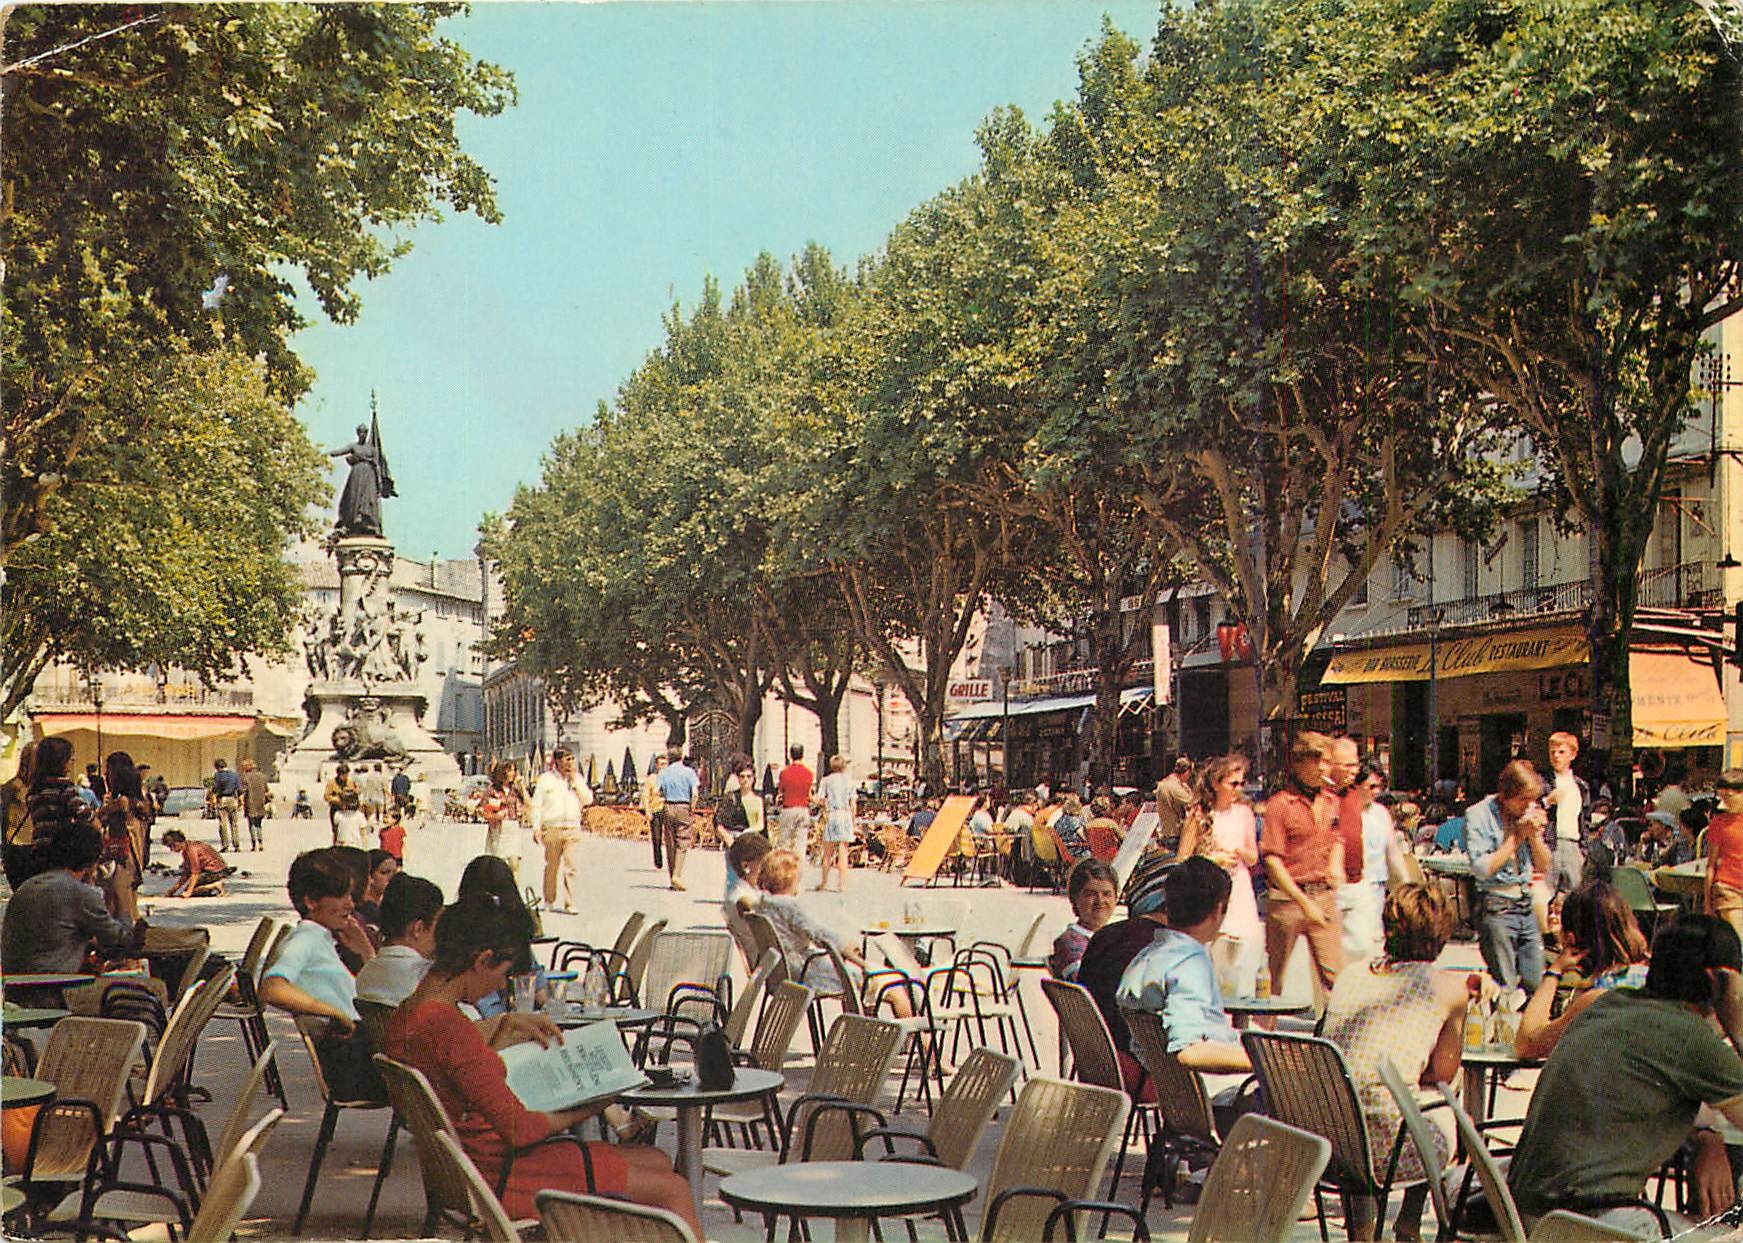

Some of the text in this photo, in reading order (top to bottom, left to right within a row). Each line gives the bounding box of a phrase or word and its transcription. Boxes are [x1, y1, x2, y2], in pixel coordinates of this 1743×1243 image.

[1441, 638, 1492, 671] Club
[1489, 639, 1550, 661] RESTAURANT
[949, 683, 988, 697] GRILLE
